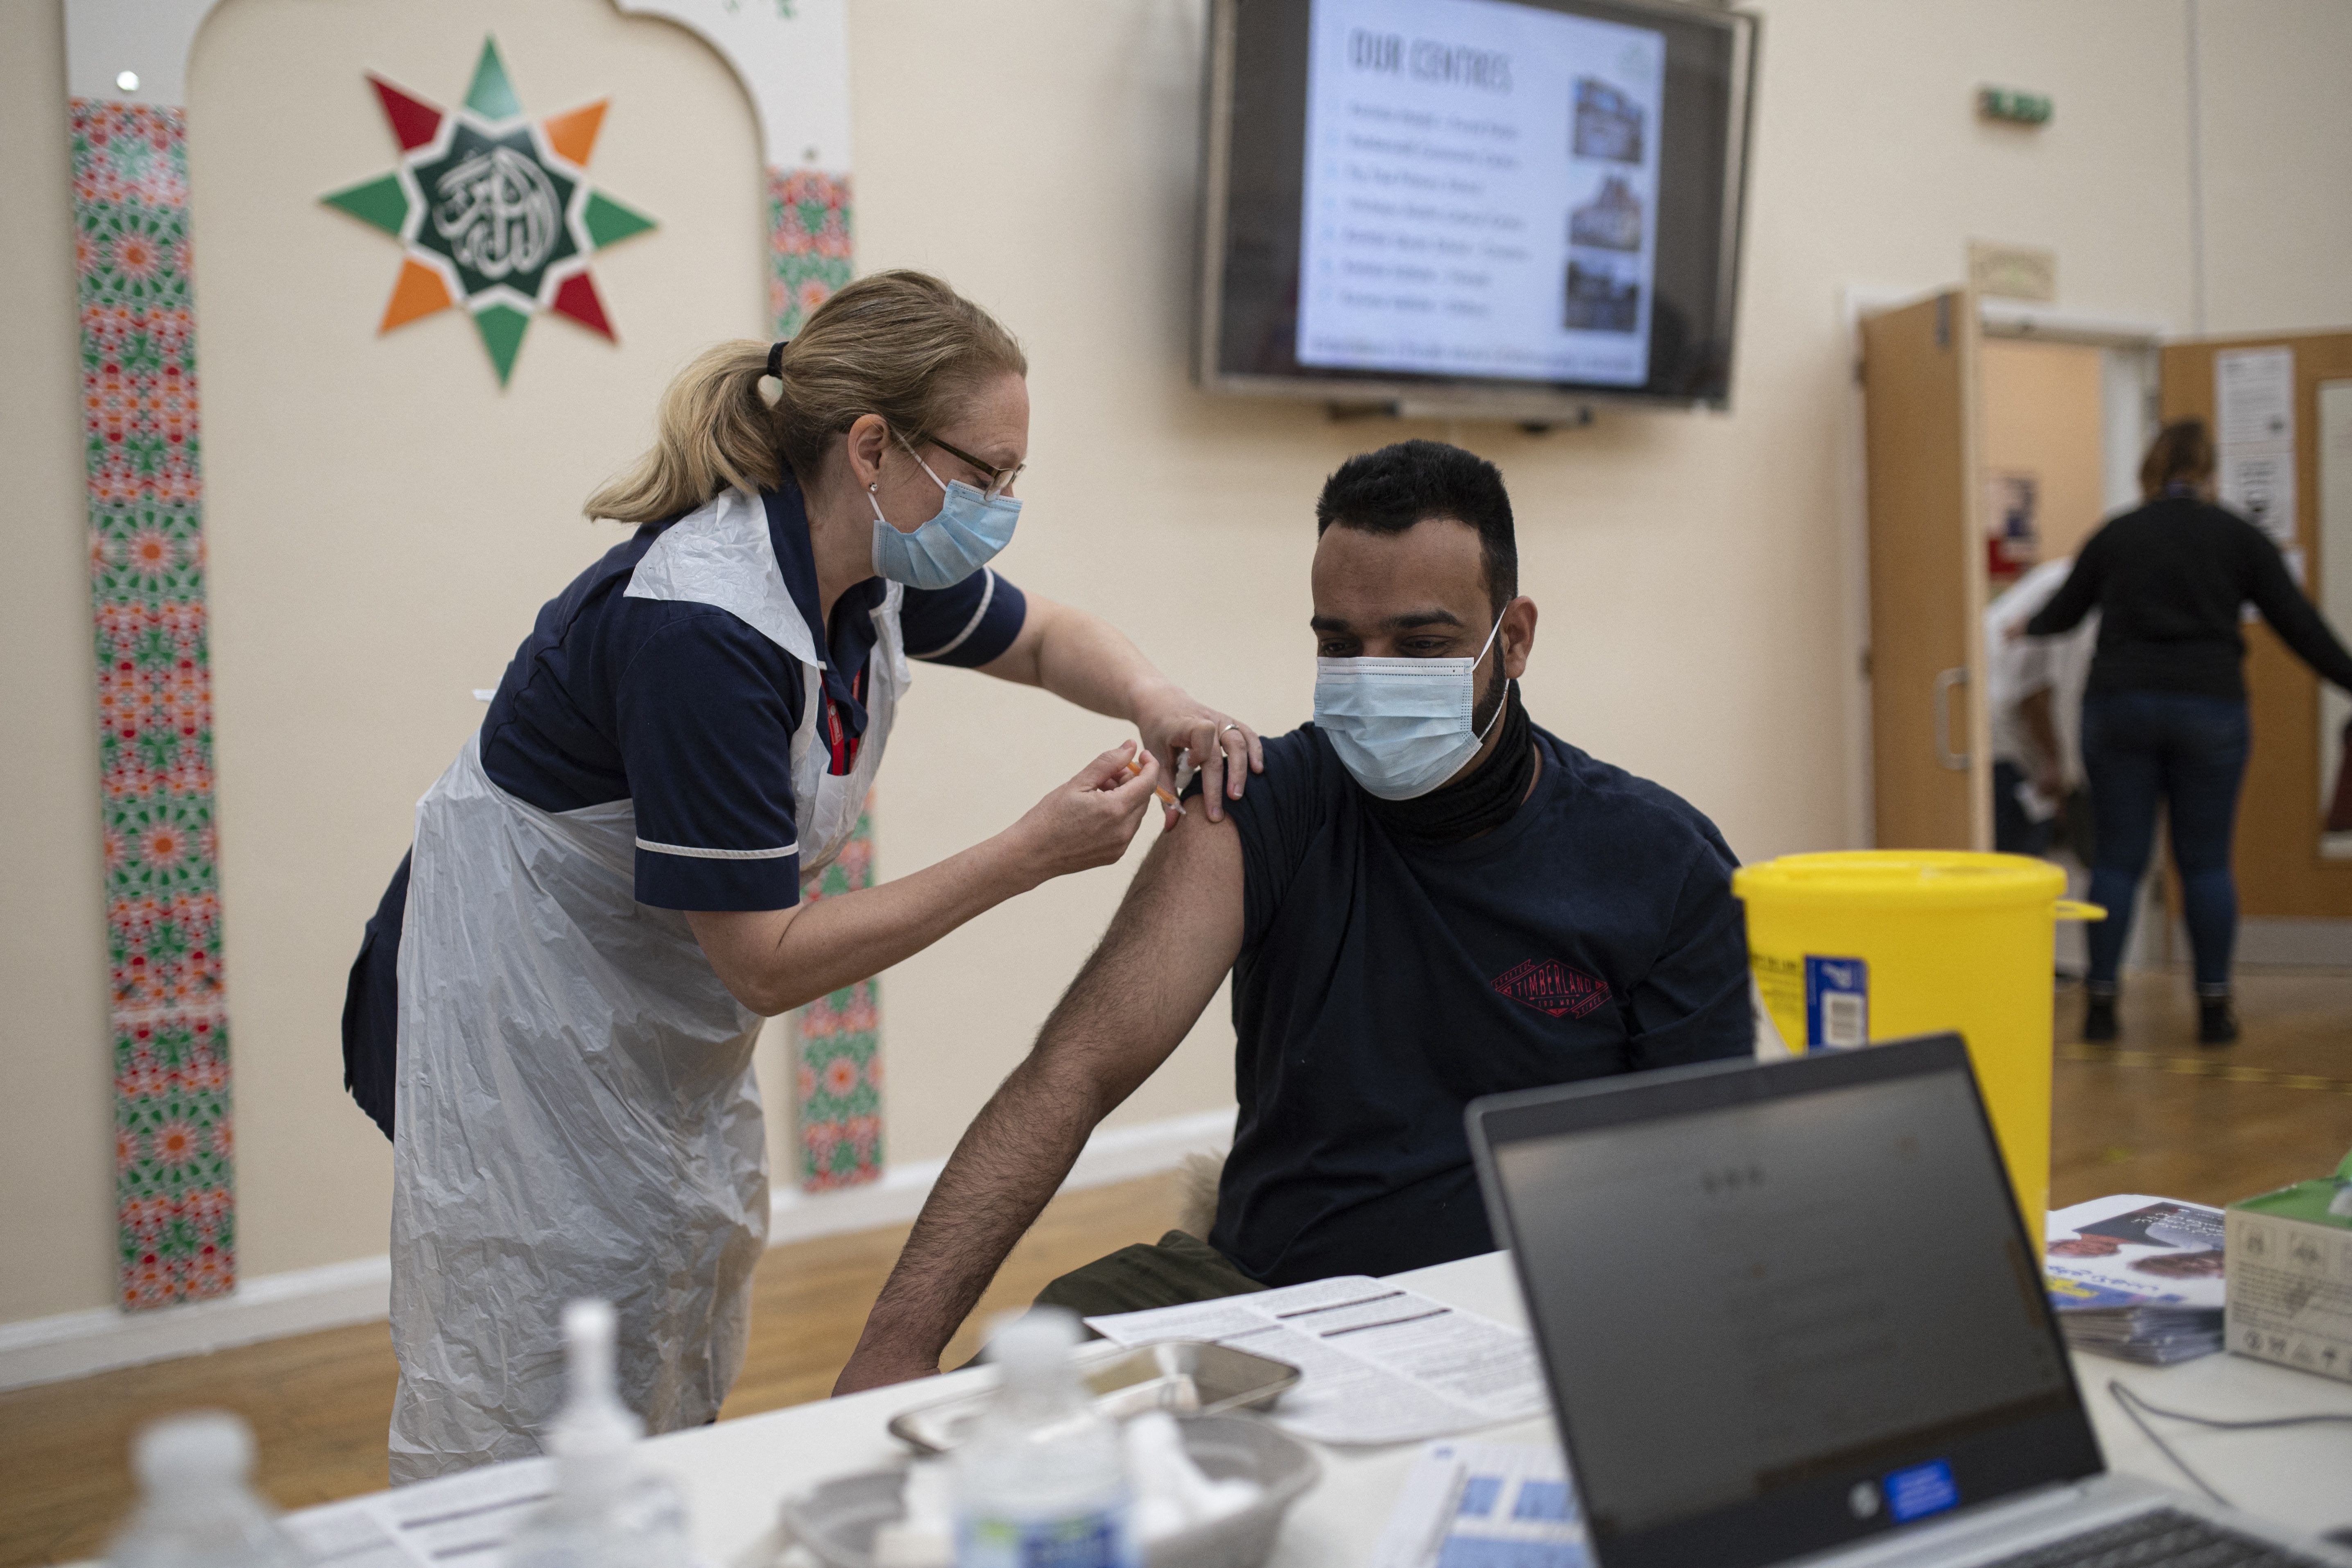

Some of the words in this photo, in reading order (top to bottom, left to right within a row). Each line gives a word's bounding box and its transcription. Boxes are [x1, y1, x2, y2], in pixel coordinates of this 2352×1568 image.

[1350, 27, 1405, 75] OUR
[1409, 38, 1513, 95] CENTRES
[1495, 964, 1528, 988] CRAFTED
[1516, 964, 1592, 996] TIMBERLAND
[1581, 997, 1601, 1013] SINCE
